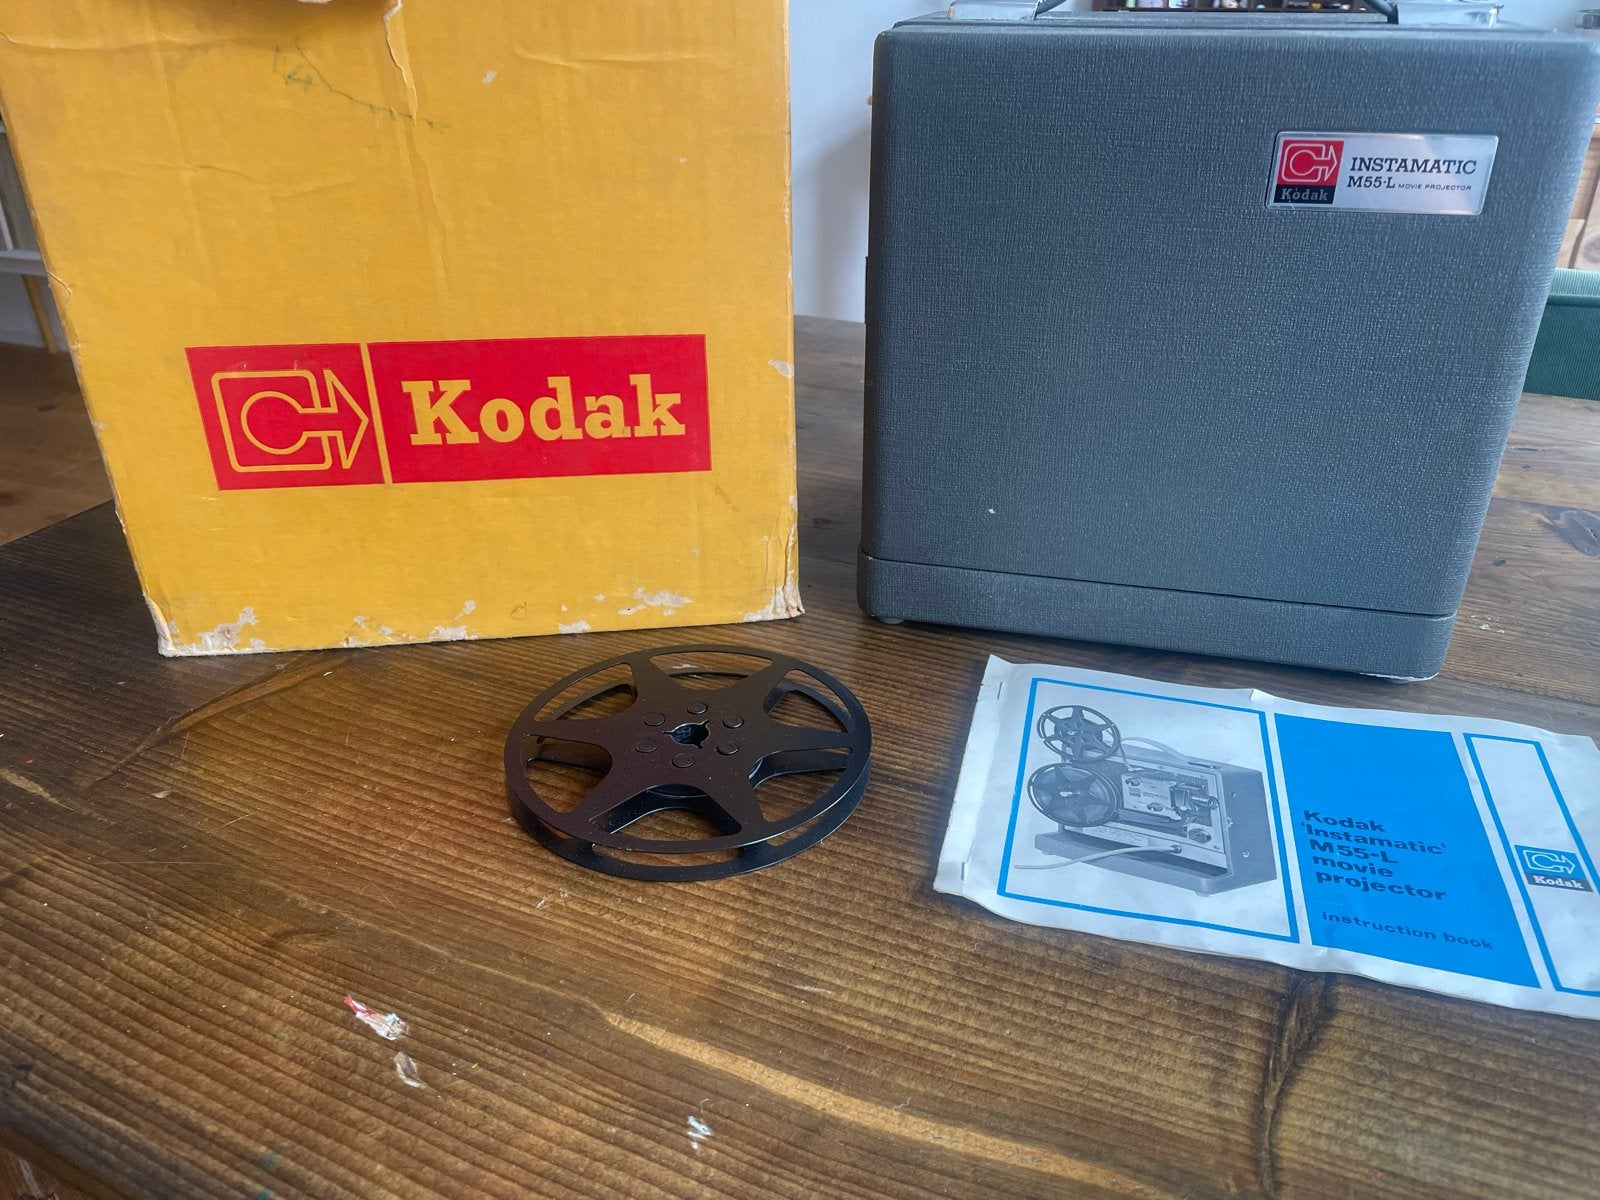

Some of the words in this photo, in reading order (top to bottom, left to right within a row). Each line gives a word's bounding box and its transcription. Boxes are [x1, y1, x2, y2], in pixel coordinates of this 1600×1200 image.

[1350, 157, 1477, 175] INSTAMATIC
[1281, 187, 1328, 201] Kodak
[402, 373, 686, 446] Kodak
[1304, 809, 1386, 833] Kodak
[1312, 856, 1394, 878] movie
[1315, 871, 1447, 900] projector
[1532, 875, 1585, 889] Kodak
[1322, 911, 1436, 940] instruction
[1443, 932, 1495, 950] book
